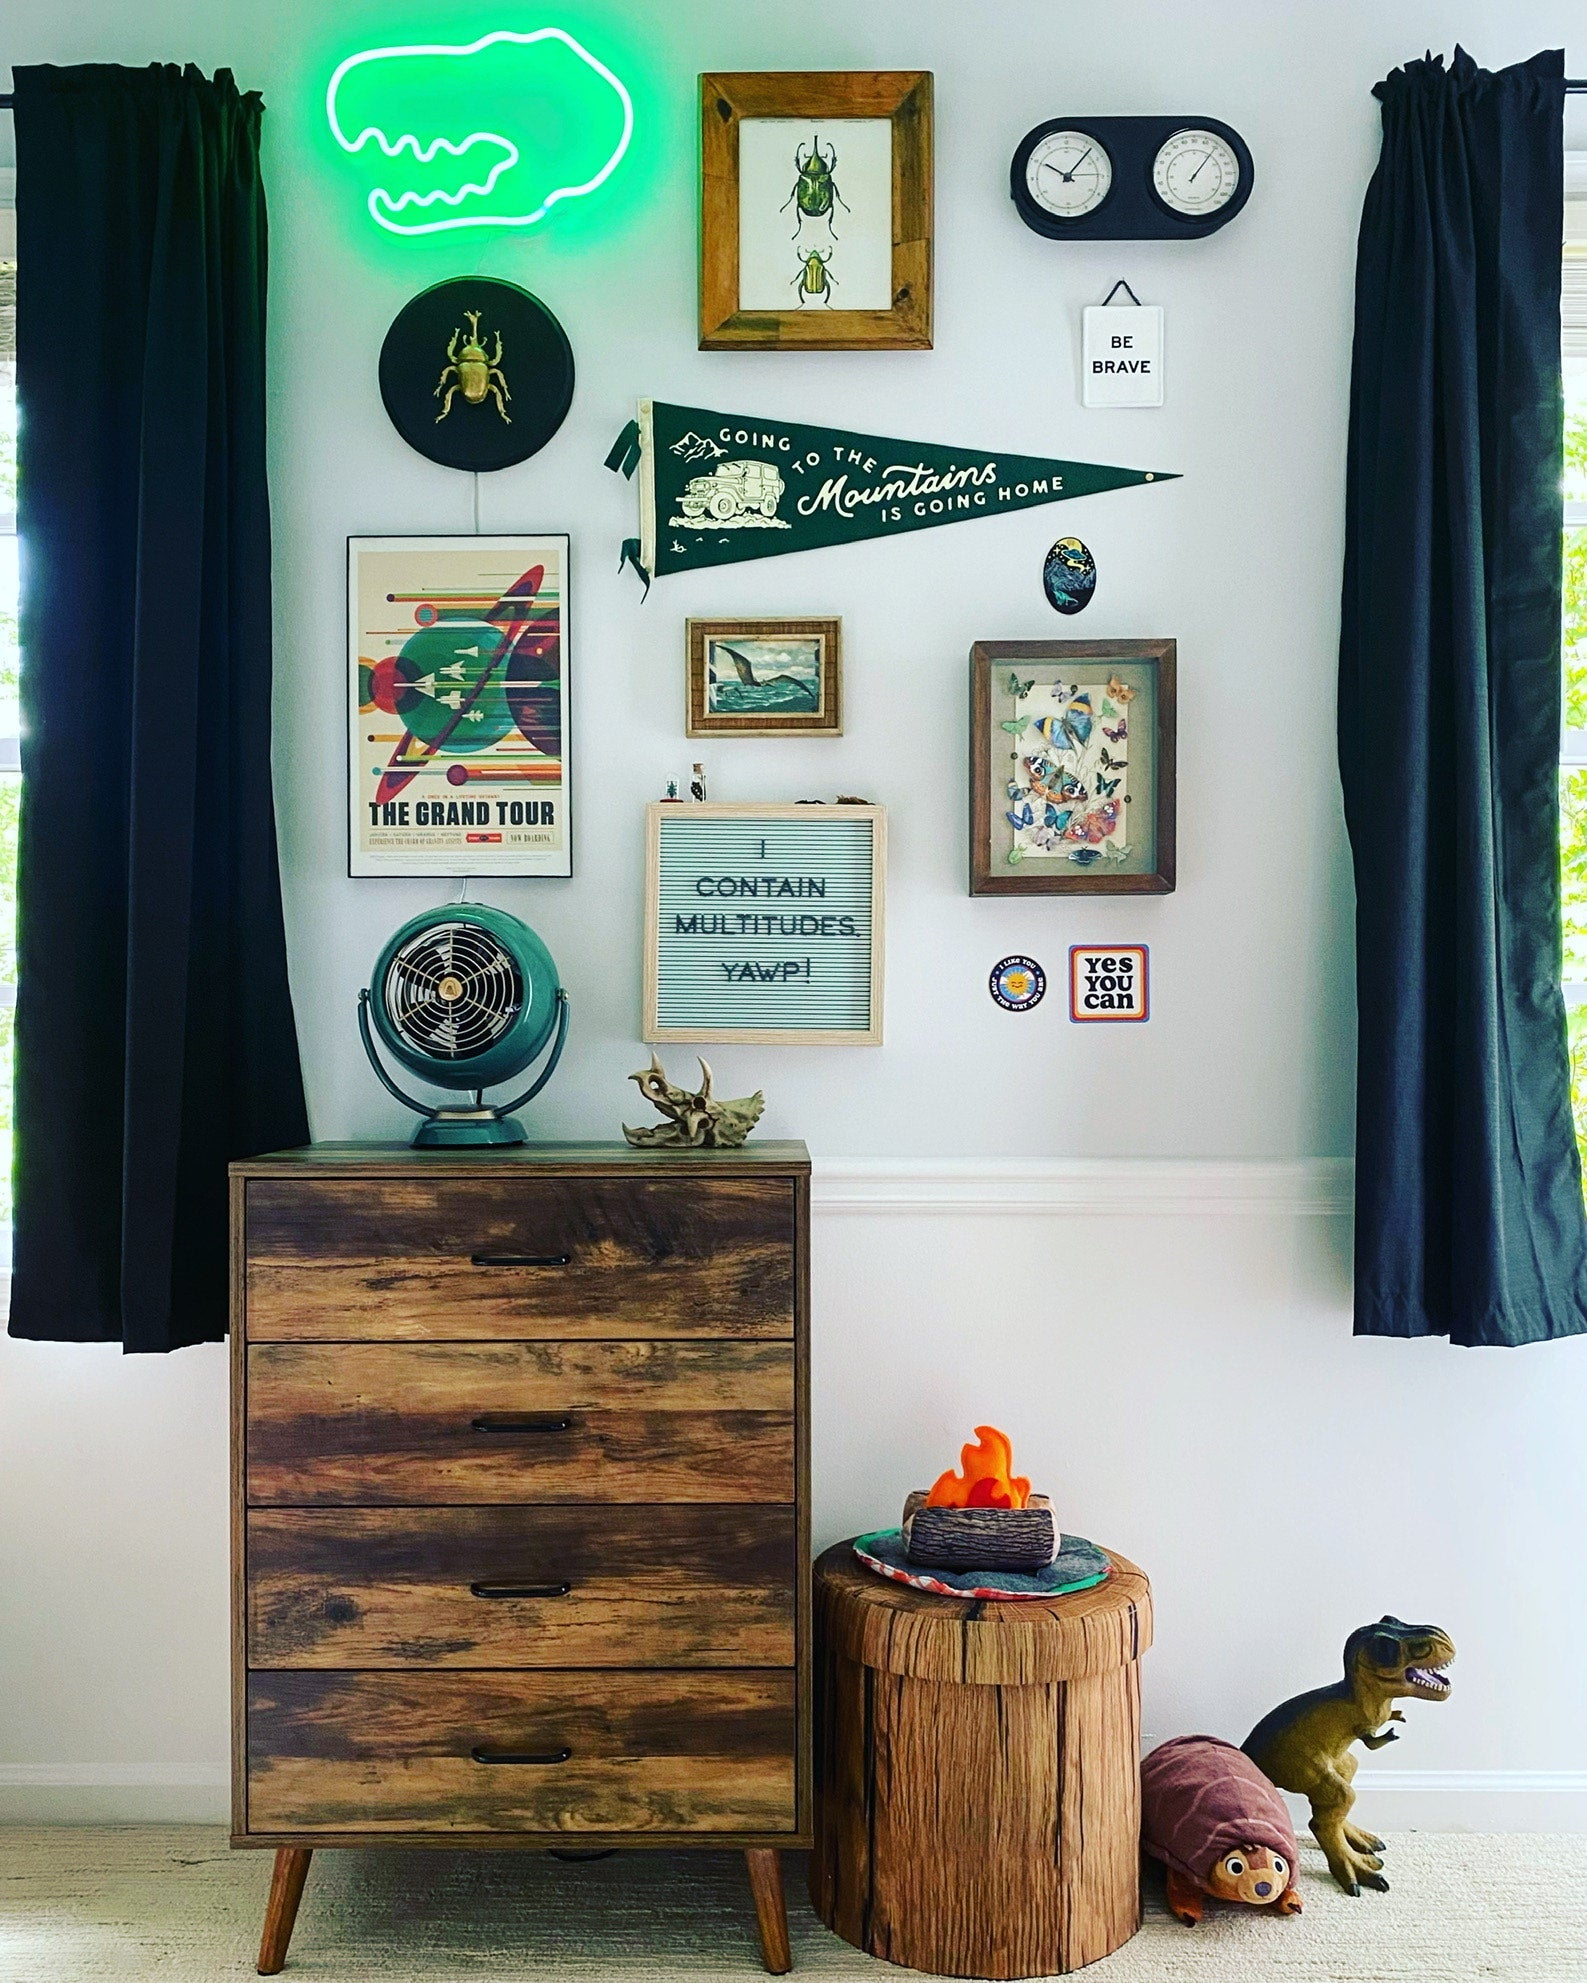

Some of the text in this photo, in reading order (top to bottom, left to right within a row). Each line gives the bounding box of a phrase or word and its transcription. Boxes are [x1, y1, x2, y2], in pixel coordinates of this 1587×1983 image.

[1110, 336, 1133, 349] BE
[1092, 360, 1151, 374] BRAVE
[718, 427, 879, 475] GOING TO THE
[796, 462, 999, 519] Mountains
[880, 475, 1065, 523] IS GOING HOME
[368, 802, 554, 826] THE GRAND TOUR
[524, 834, 551, 842] BOARDING
[760, 839, 767, 860] I
[696, 876, 826, 898] CONTAIN
[721, 957, 811, 984] YAWP!
[1003, 958, 1020, 966] LIKE
[1022, 958, 1036, 969] YOU
[1084, 975, 1134, 992] YOU
[1084, 993, 1134, 1010] can
